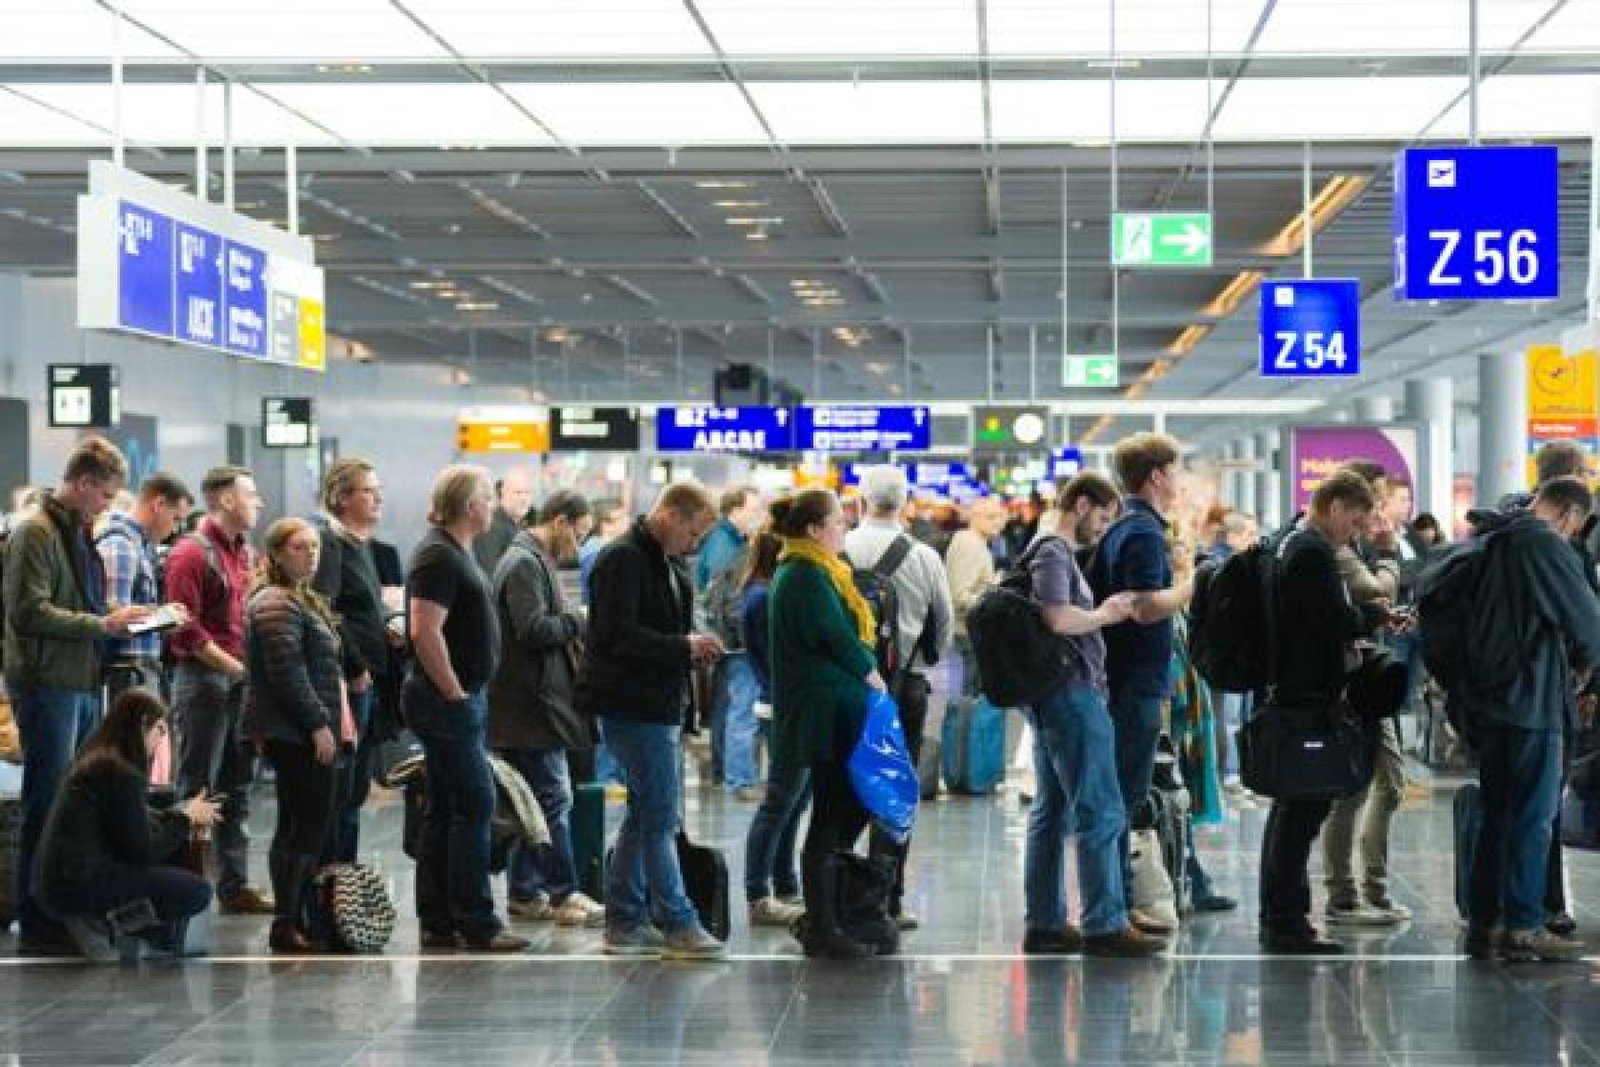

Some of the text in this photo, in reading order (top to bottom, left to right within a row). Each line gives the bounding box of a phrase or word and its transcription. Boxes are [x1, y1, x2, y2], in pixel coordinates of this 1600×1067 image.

[1428, 229, 1539, 285] Z 56
[1274, 331, 1347, 369] Z 54
